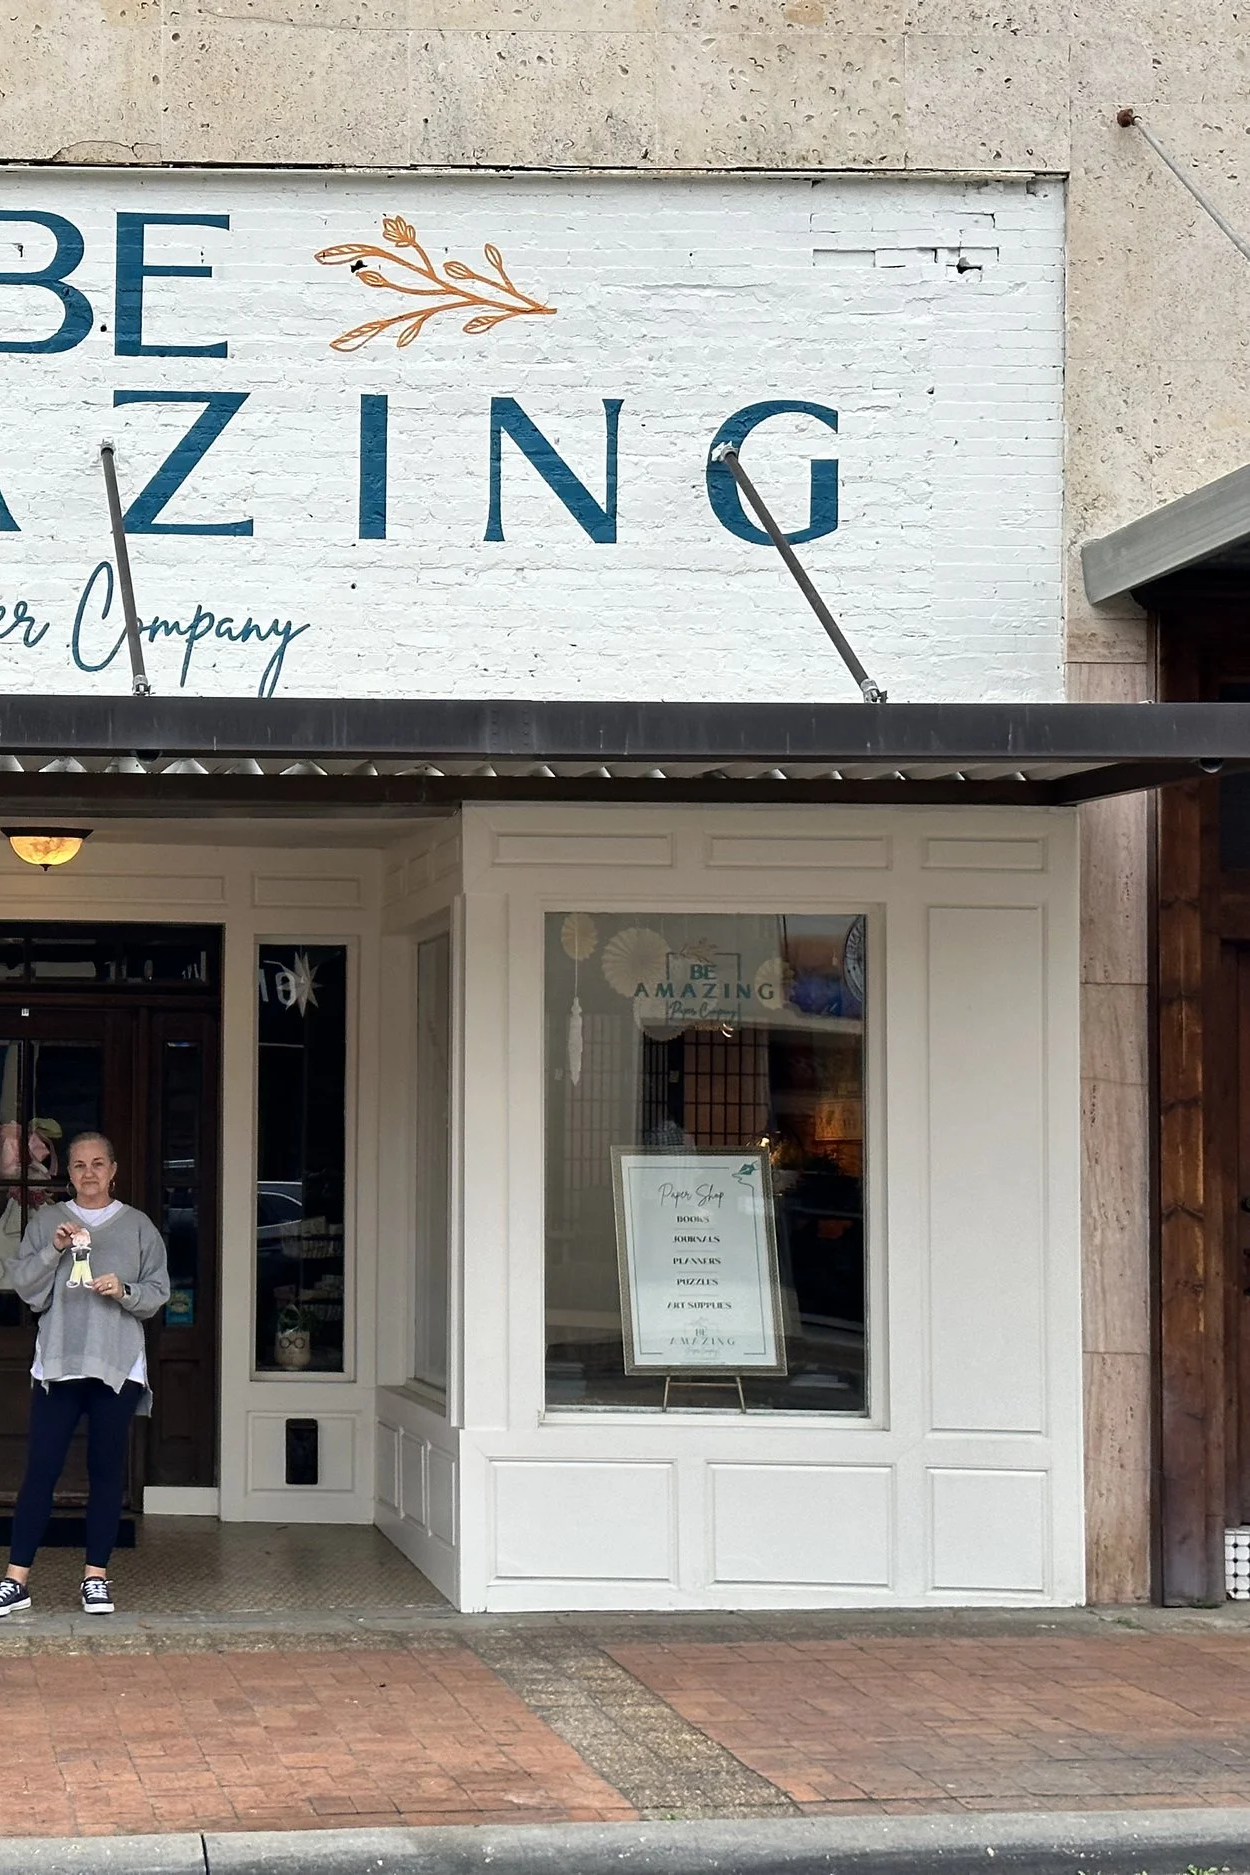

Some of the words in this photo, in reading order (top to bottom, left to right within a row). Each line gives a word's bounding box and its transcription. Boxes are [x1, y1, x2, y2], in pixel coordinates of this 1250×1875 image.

[72, 561, 310, 699] Cmpany
[690, 964, 717, 980] BE
[634, 982, 774, 1000] AMAZING
[658, 1182, 692, 1208] Paper
[695, 1184, 724, 1208] Shop
[676, 1215, 710, 1223] BOOKS
[673, 1235, 721, 1243] JOURNALS
[673, 1257, 722, 1265] PLANNERS
[677, 1278, 719, 1286] PUZZLES
[666, 1301, 686, 1309] ART
[687, 1301, 732, 1310] SUPPLIES
[669, 1337, 735, 1346] AMAZING
